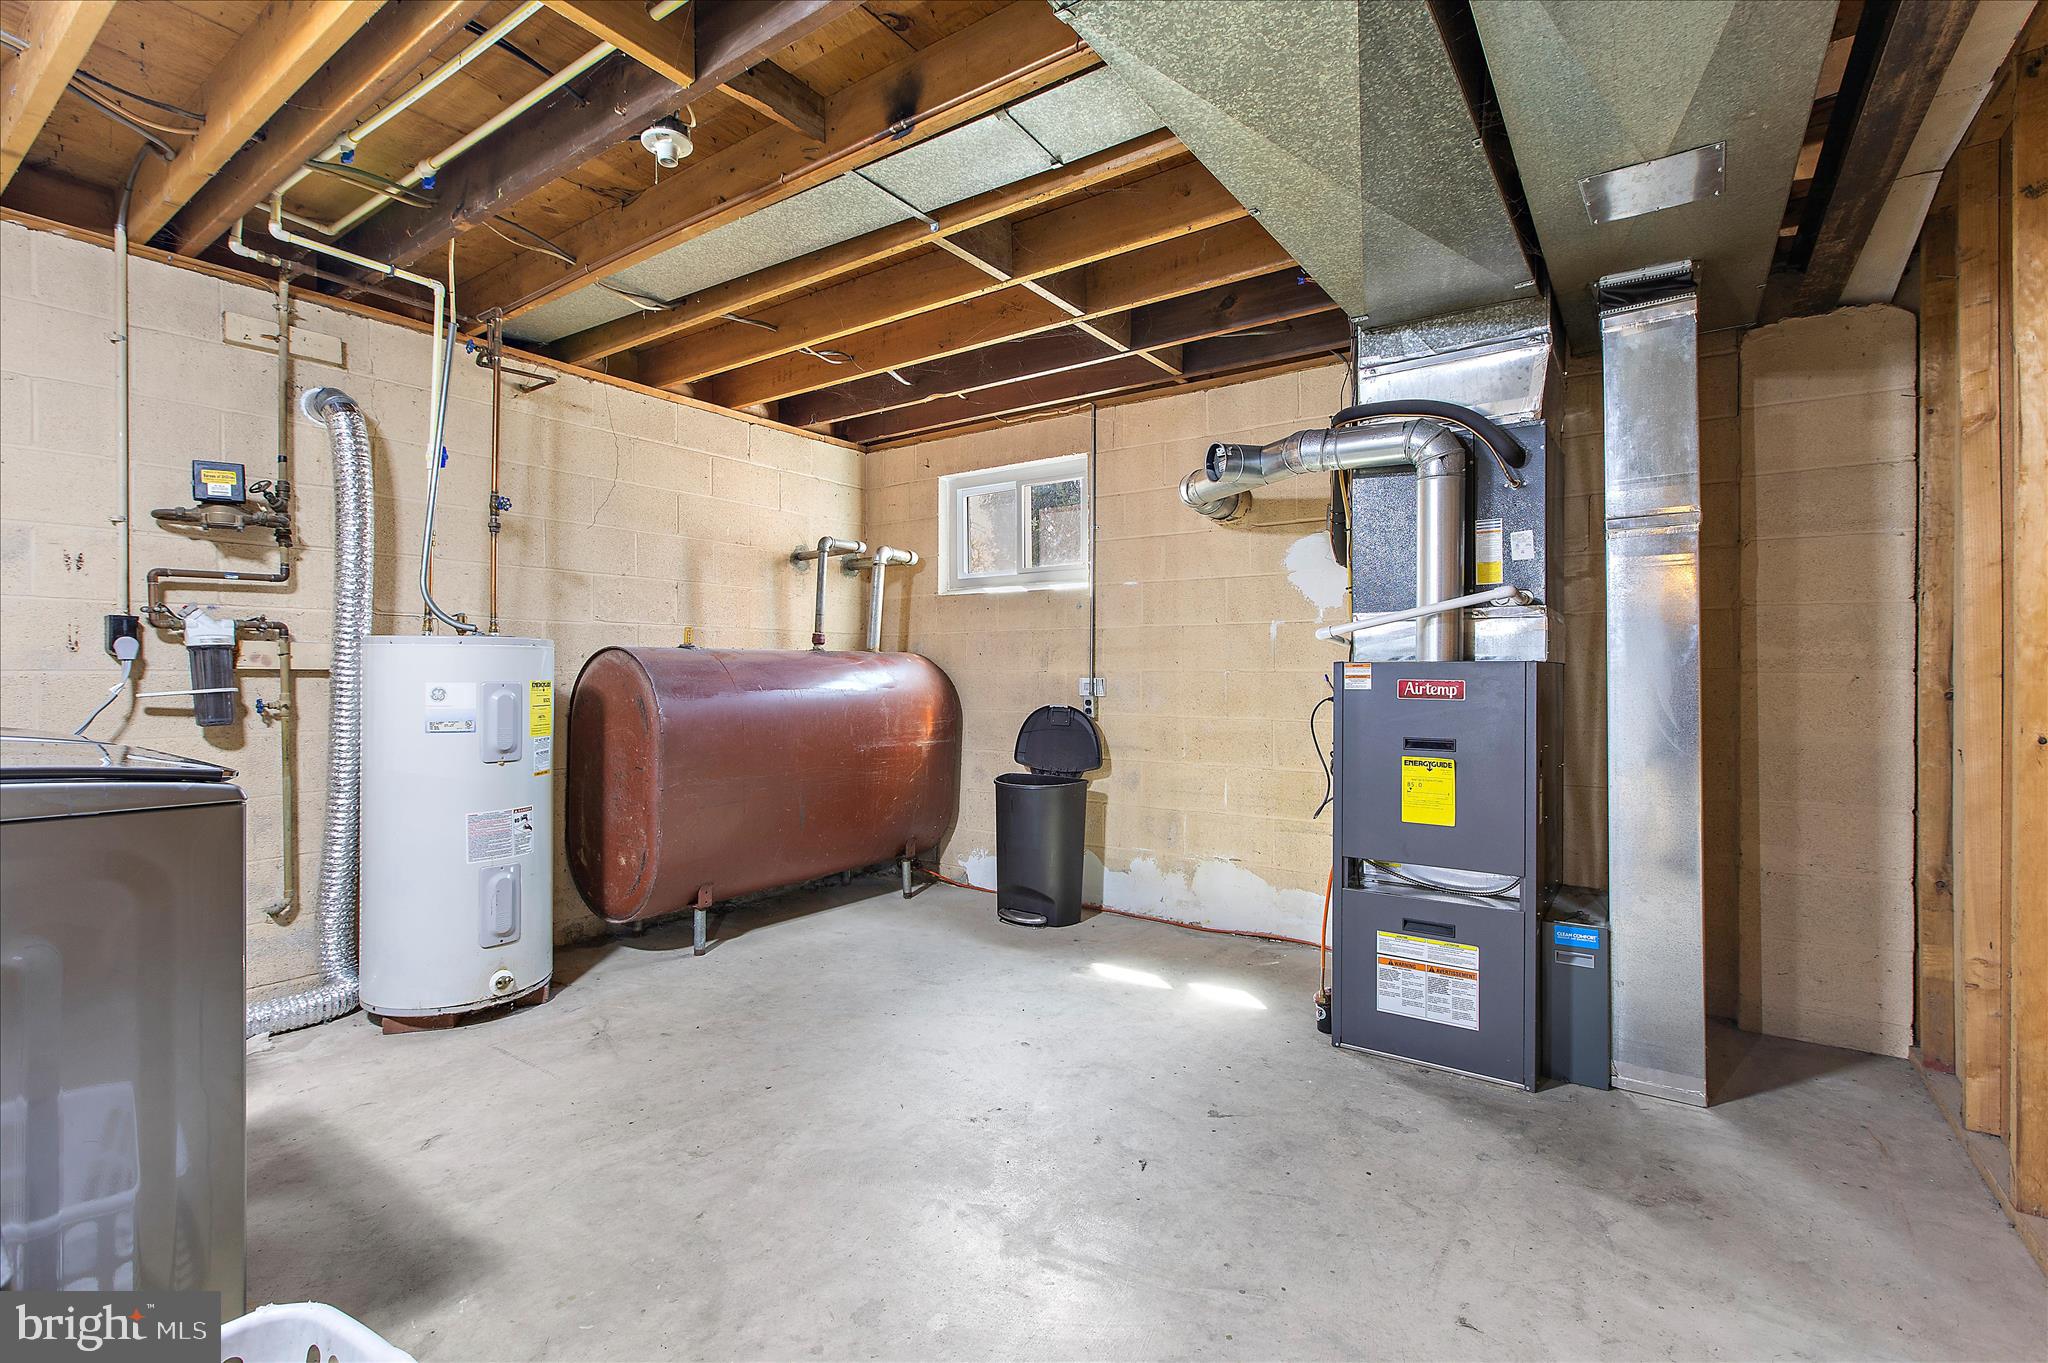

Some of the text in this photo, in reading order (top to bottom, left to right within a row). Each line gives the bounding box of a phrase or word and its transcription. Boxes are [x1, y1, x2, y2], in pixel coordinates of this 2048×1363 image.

[1404, 682, 1458, 698] Airtemp
[1404, 760, 1453, 769] ENERGYGUIDE
[1394, 961, 1417, 969] WARNING
